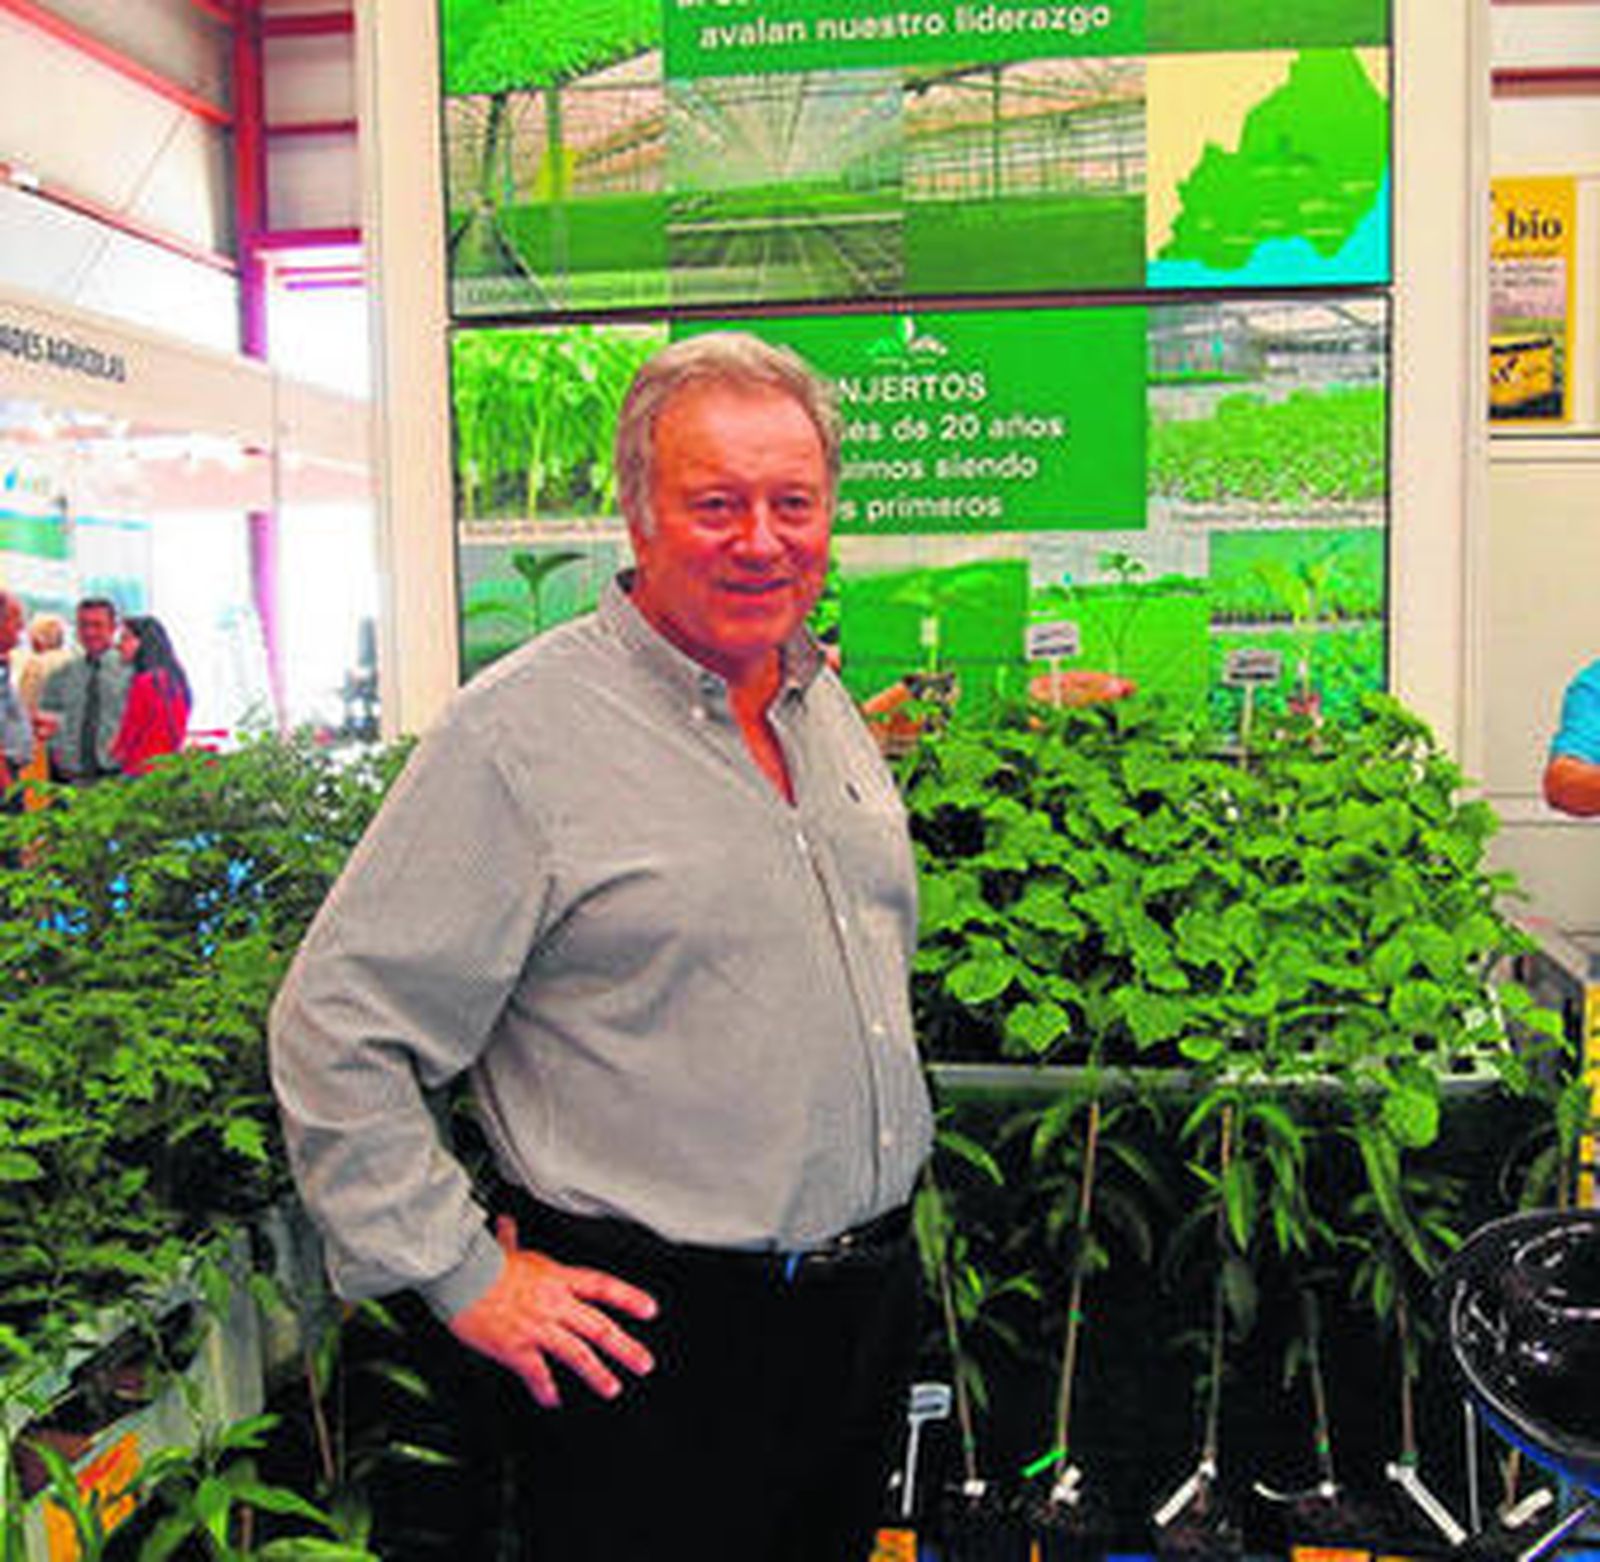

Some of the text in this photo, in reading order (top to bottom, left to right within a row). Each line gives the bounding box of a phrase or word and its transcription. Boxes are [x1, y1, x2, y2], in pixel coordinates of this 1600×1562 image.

[699, 2, 1112, 50] avalan nuestro liderazgo
[1507, 208, 1563, 241] bio
[891, 415, 929, 442] de
[939, 413, 981, 441] 20
[935, 450, 1039, 480] siendo
[866, 490, 1003, 524] primeros
